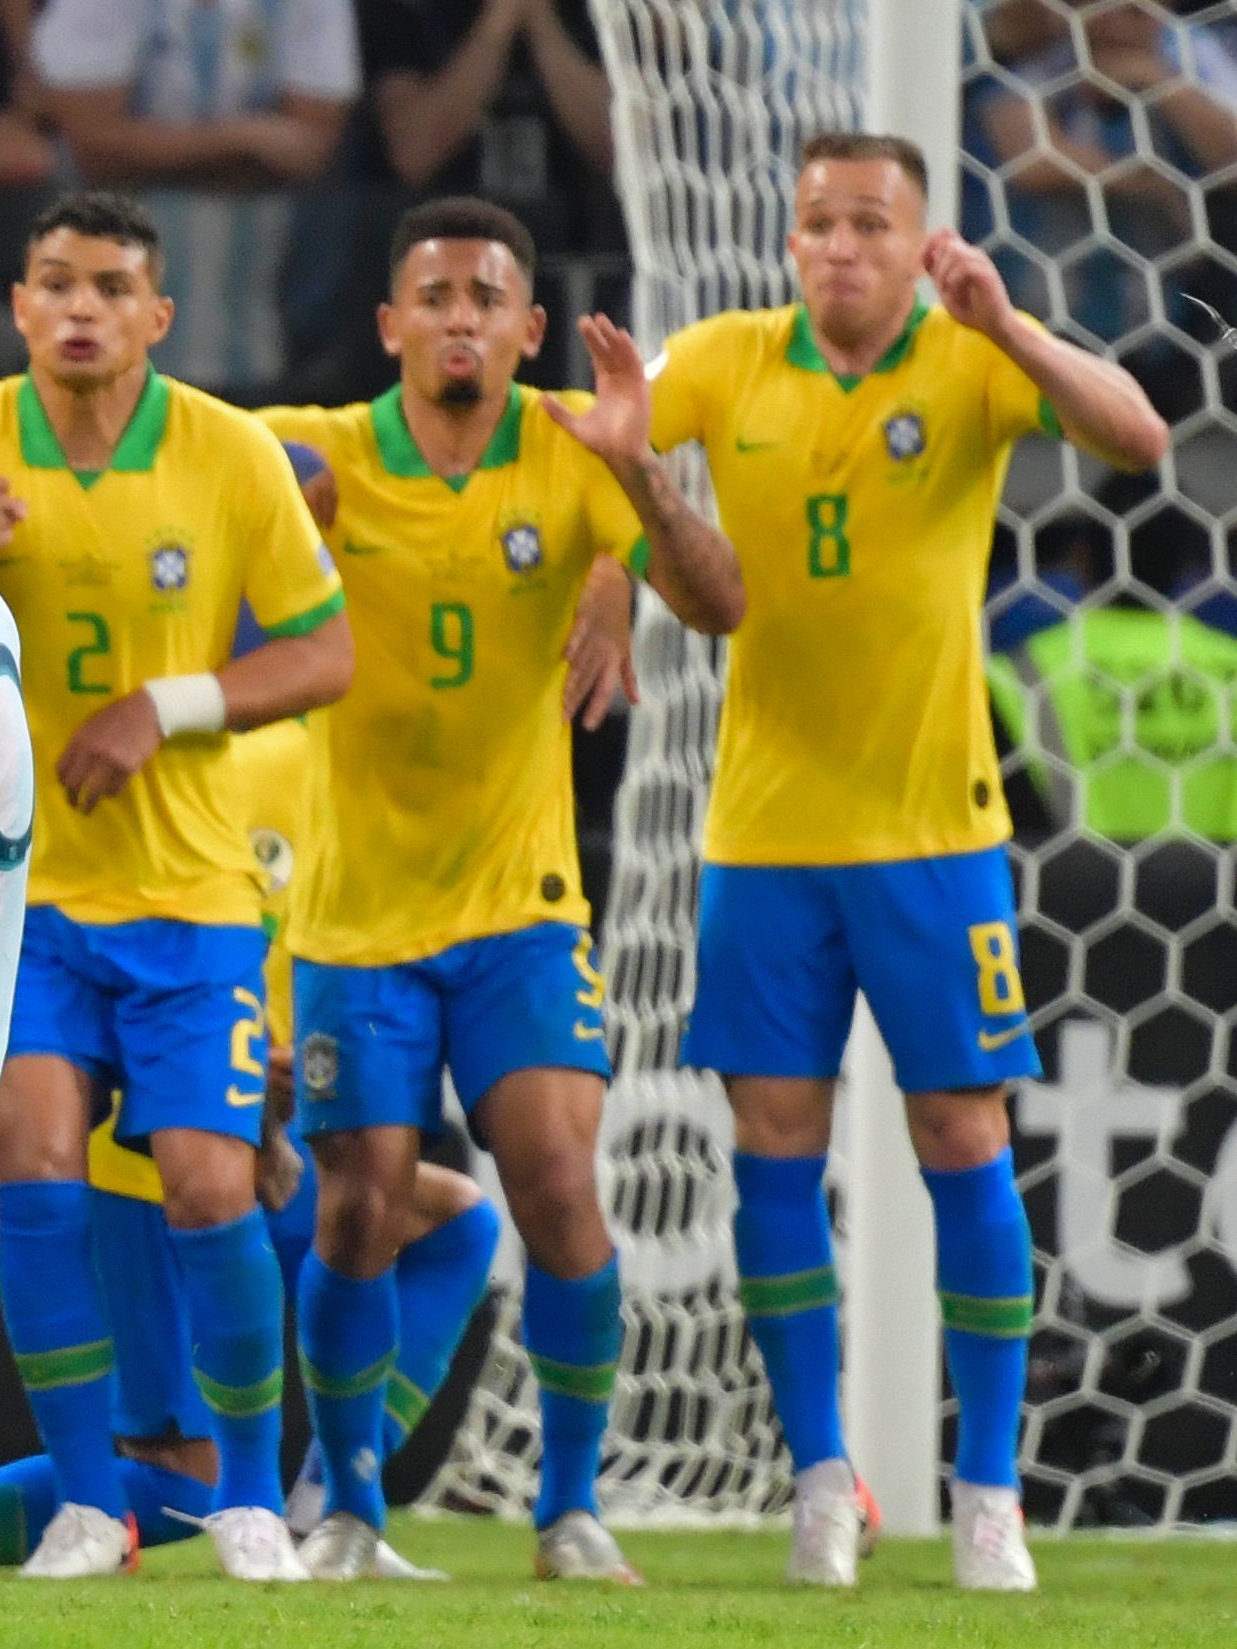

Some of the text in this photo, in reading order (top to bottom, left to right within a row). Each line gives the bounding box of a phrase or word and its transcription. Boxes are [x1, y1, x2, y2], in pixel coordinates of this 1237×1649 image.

[806, 494, 851, 578] 8
[67, 611, 112, 694] 2
[430, 602, 474, 689] 9
[969, 921, 1026, 1017] 8
